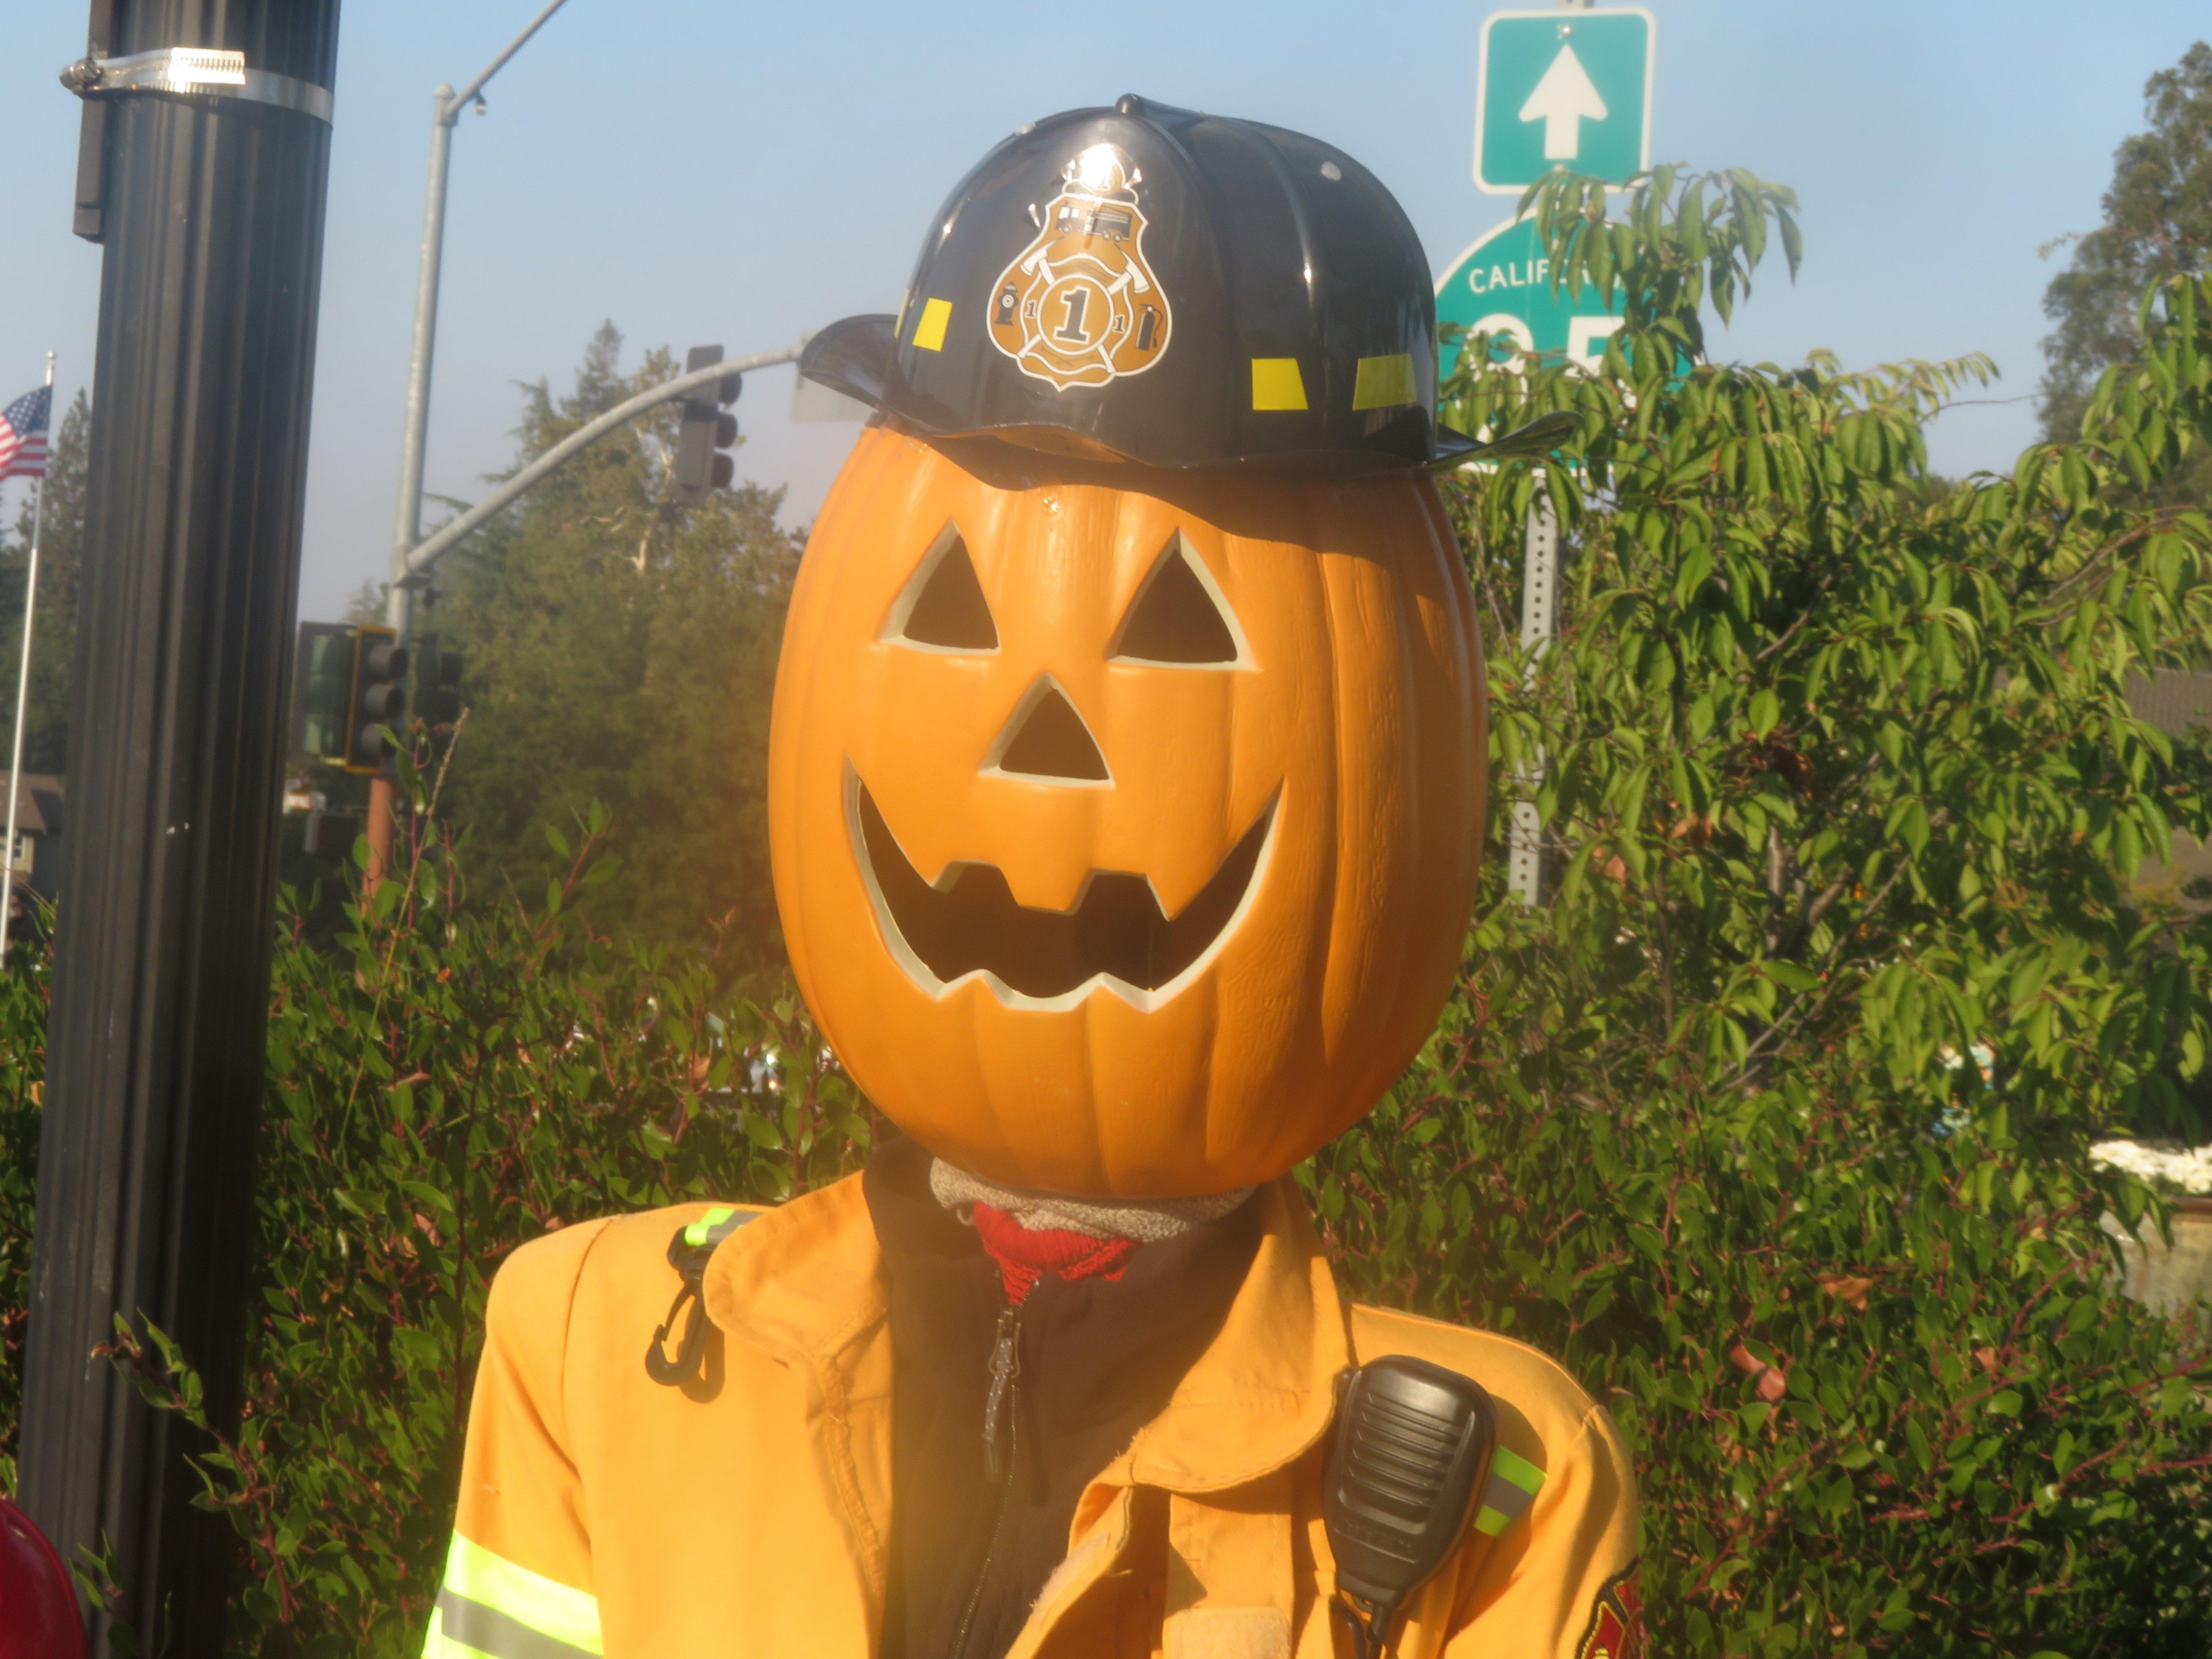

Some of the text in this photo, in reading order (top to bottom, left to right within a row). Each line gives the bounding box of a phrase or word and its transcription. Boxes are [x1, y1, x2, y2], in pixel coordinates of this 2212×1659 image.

[1025, 300, 1036, 317] 1
[1053, 285, 1091, 345] 1
[1112, 314, 1126, 333] 1
